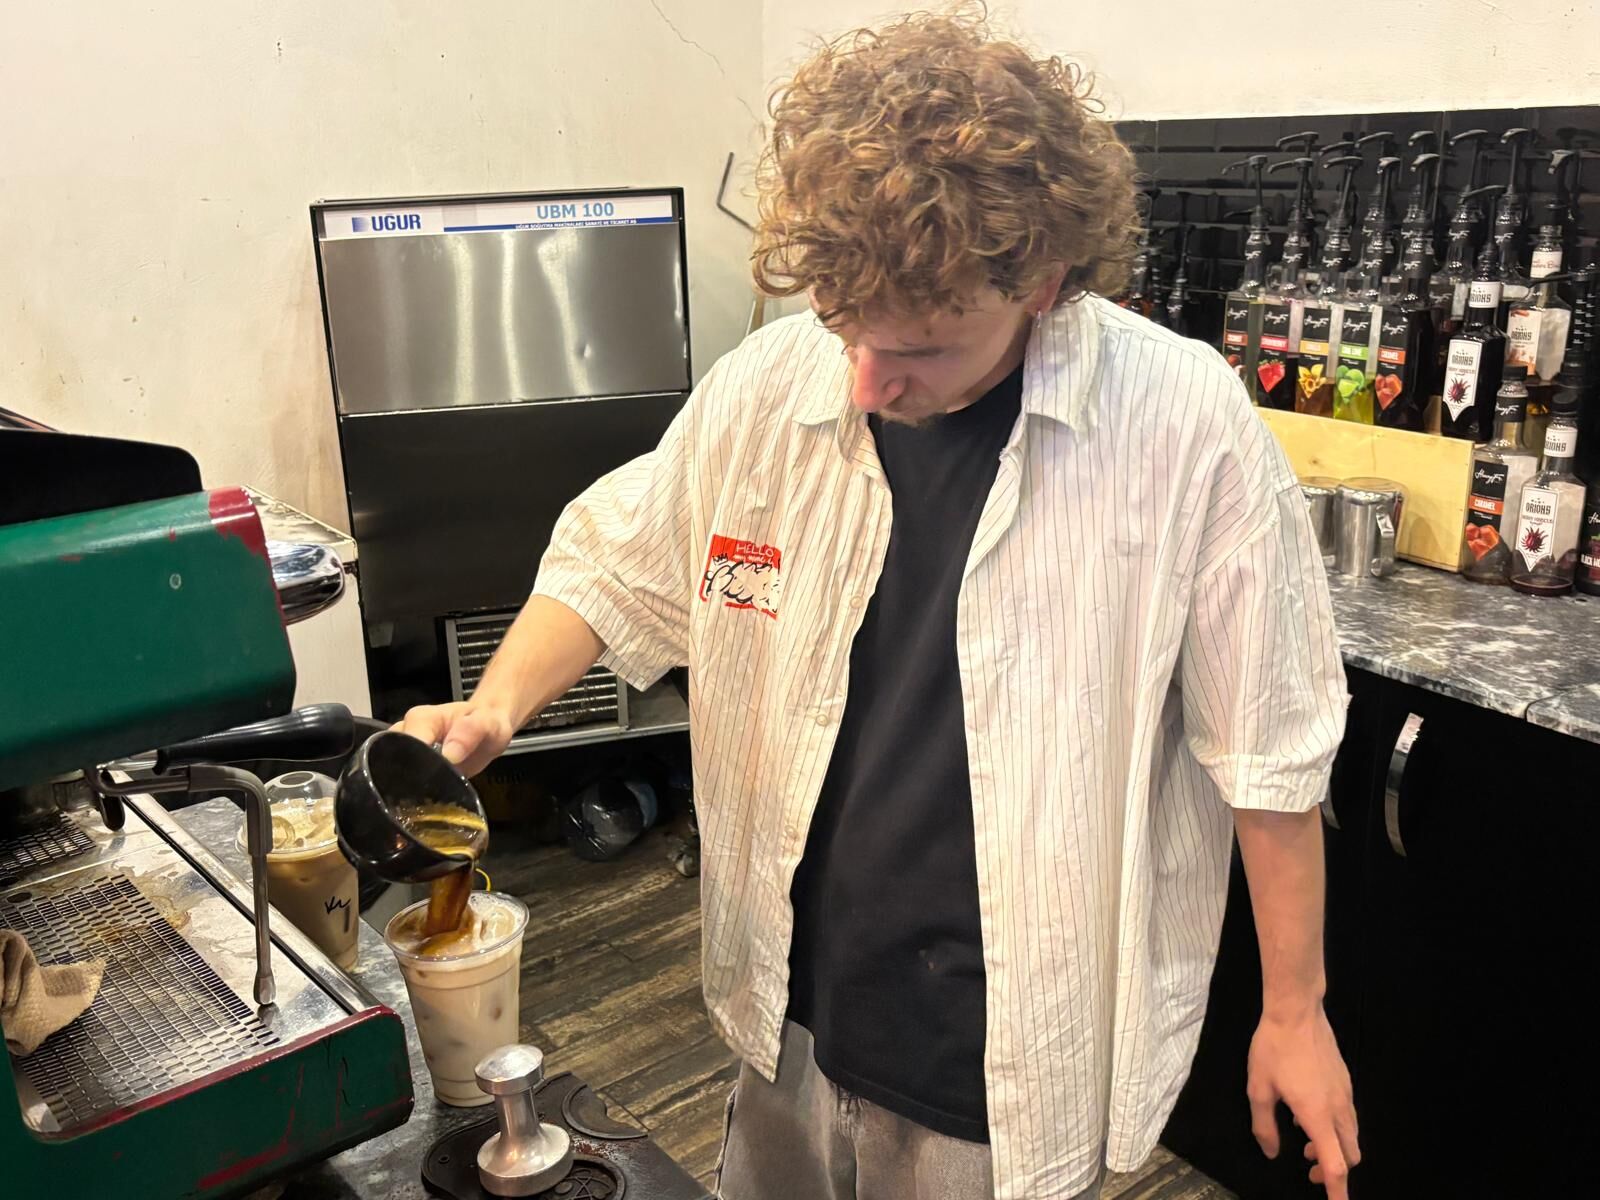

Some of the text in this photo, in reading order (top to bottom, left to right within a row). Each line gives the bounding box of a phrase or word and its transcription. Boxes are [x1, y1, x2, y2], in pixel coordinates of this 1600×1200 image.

[536, 202, 614, 219] UBM 100
[1474, 497, 1495, 510] CARAMEL
[736, 543, 774, 557] HELLO
